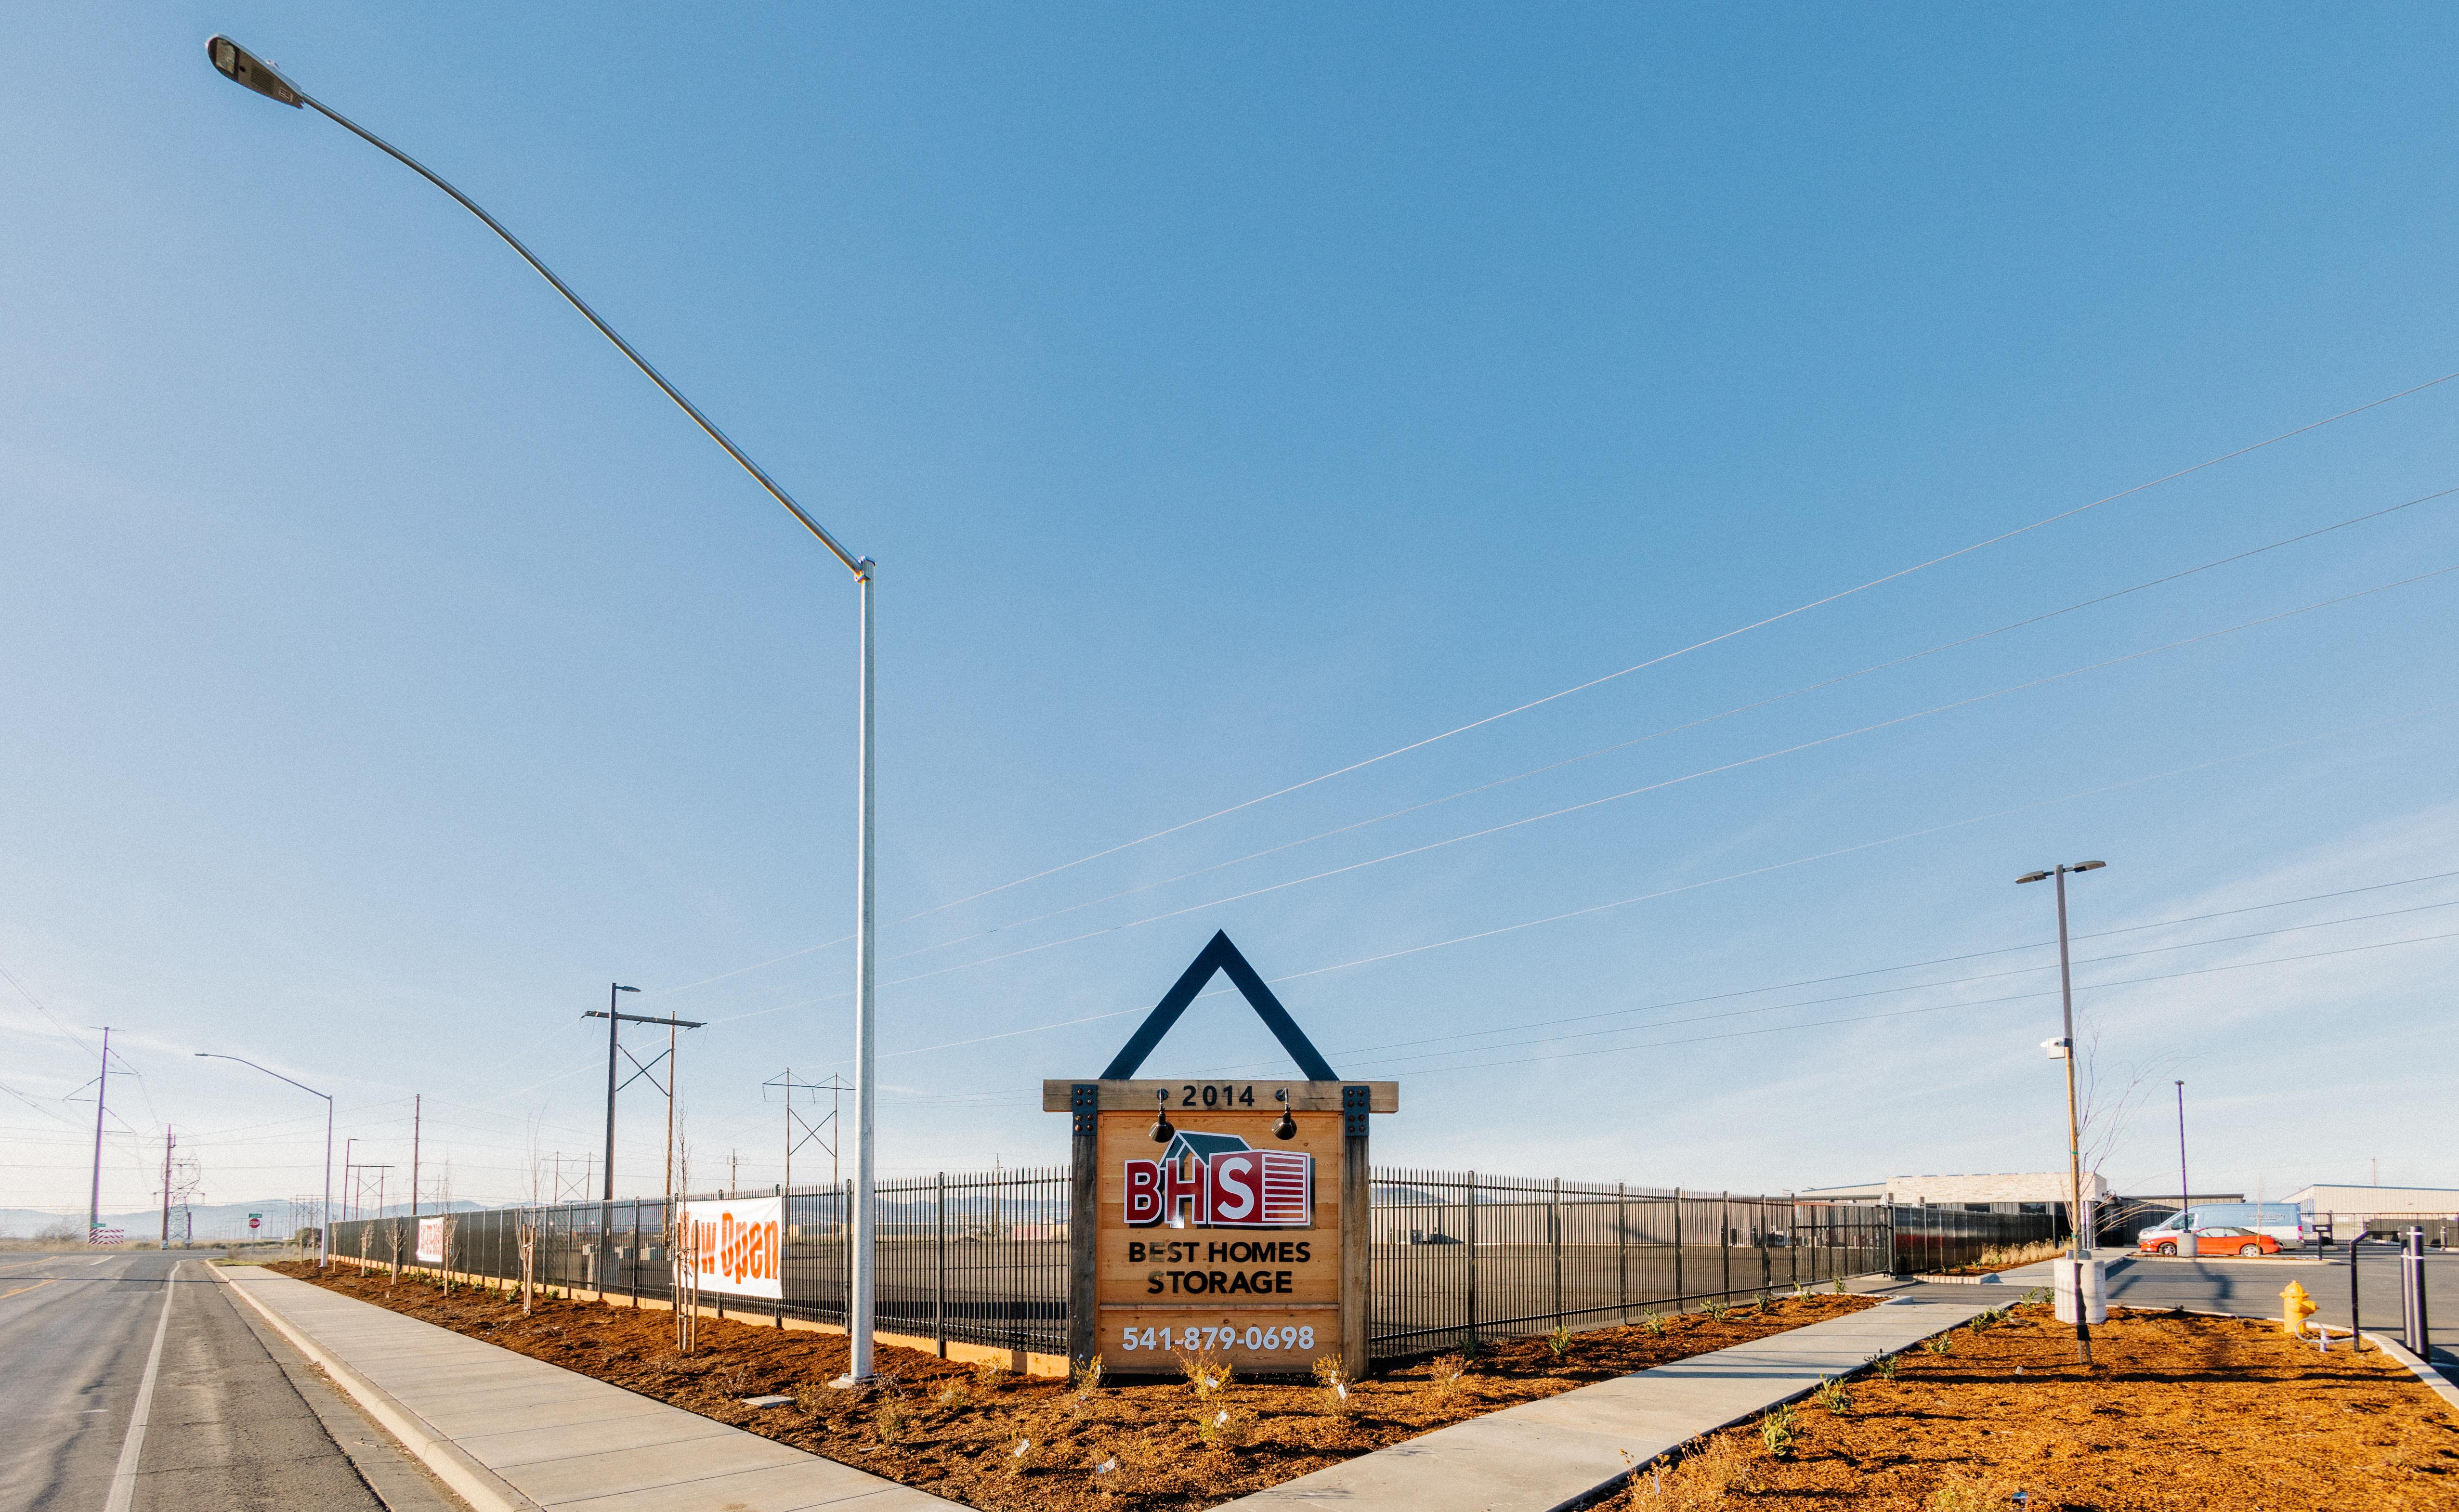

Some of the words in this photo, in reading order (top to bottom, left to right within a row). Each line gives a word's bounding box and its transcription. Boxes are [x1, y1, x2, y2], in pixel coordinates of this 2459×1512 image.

[1182, 1085, 1255, 1107] 2014
[1124, 1157, 1255, 1224] BHS
[721, 1210, 778, 1284] Open
[1129, 1241, 1200, 1263] BEST
[1209, 1241, 1310, 1263] HOMES
[1147, 1270, 1293, 1294] STORAGE
[1122, 1326, 1314, 1350] 541-879-0698
